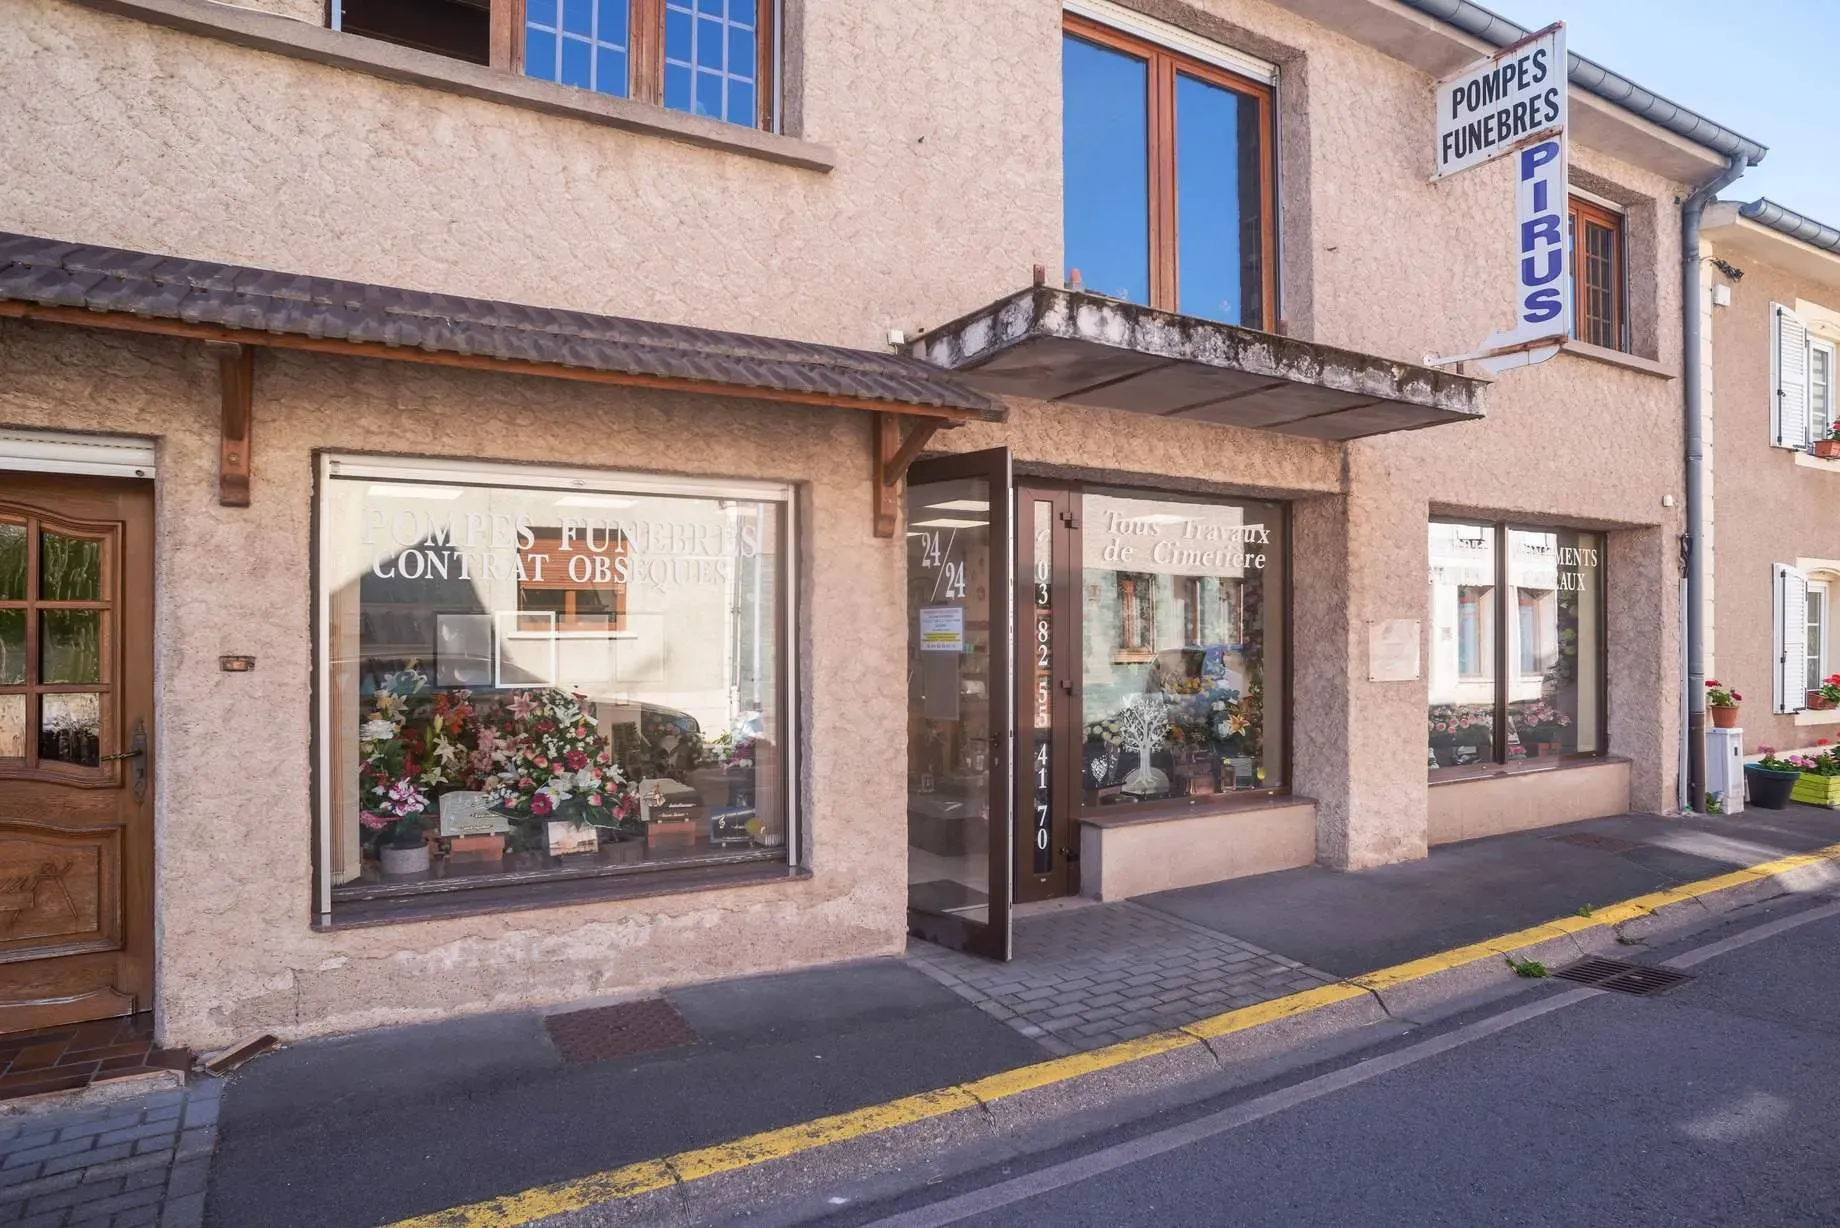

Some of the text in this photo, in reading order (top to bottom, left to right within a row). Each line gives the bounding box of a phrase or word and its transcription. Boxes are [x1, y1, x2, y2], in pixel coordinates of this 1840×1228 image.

[1452, 48, 1548, 120] POMPES
[1442, 87, 1560, 165] FUNEBRES
[1521, 141, 1562, 324] PIRUS
[362, 508, 759, 559] POMPES FUNEBRES
[1103, 538, 1135, 563] de
[1104, 509, 1271, 545] Tous Travaux
[372, 548, 729, 594] CONTRAT OBSEQUES
[1556, 571, 1586, 591] AUX
